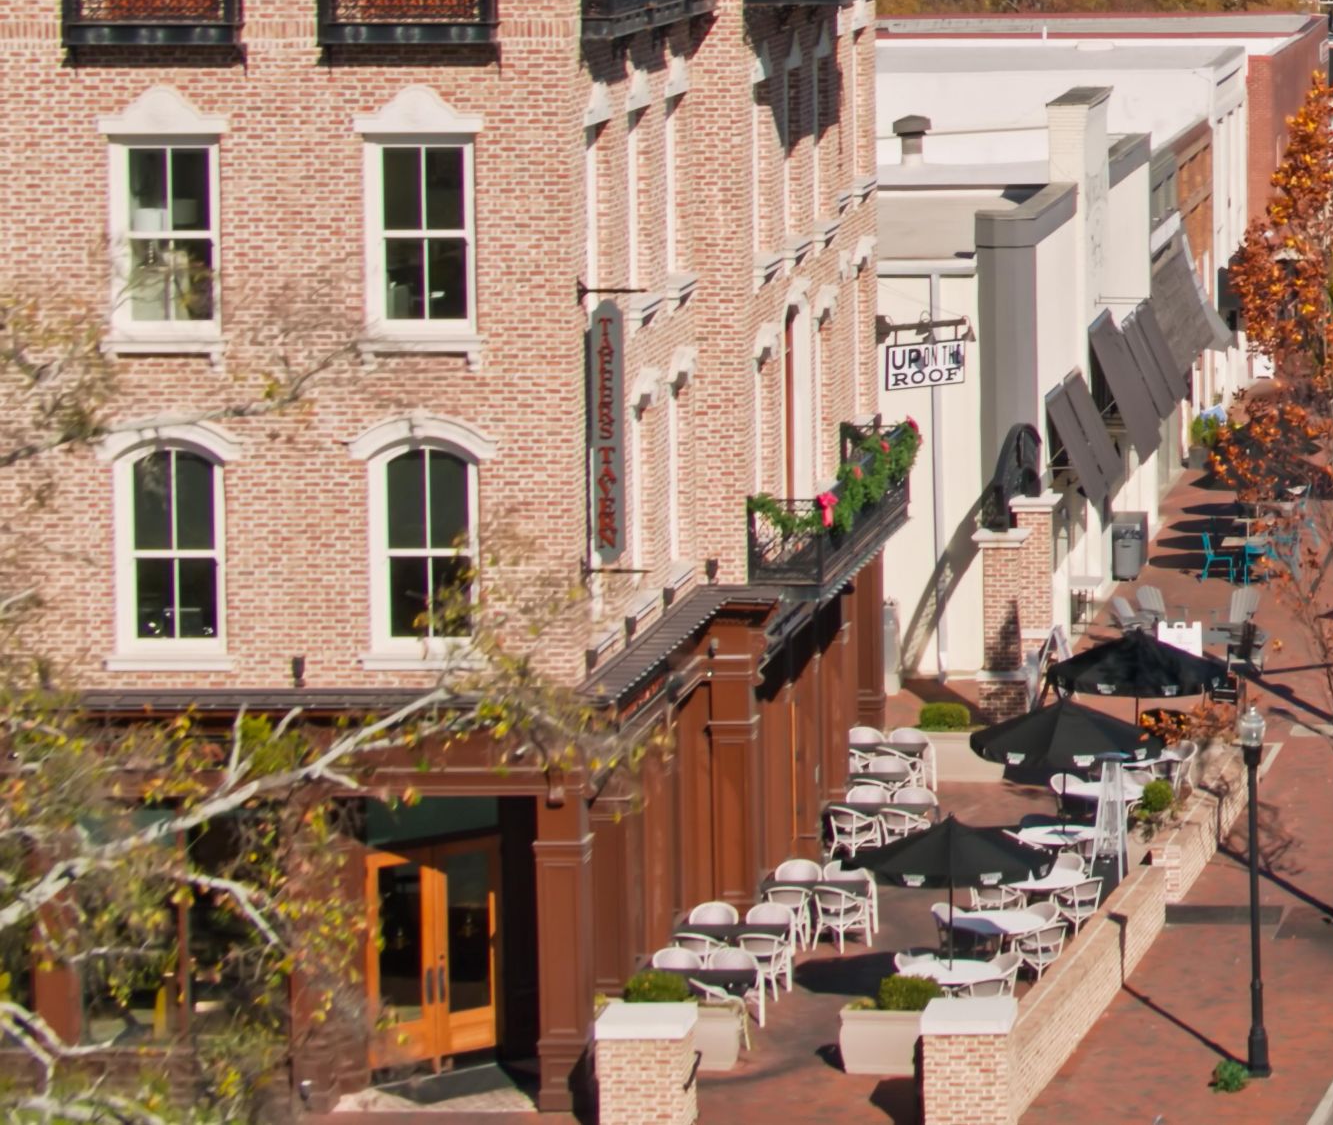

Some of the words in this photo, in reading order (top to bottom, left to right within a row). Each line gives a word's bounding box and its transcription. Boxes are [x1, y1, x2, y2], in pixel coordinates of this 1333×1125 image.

[892, 348, 921, 370] UP
[892, 367, 958, 387] ROOF
[597, 446, 617, 550] TAVERN
